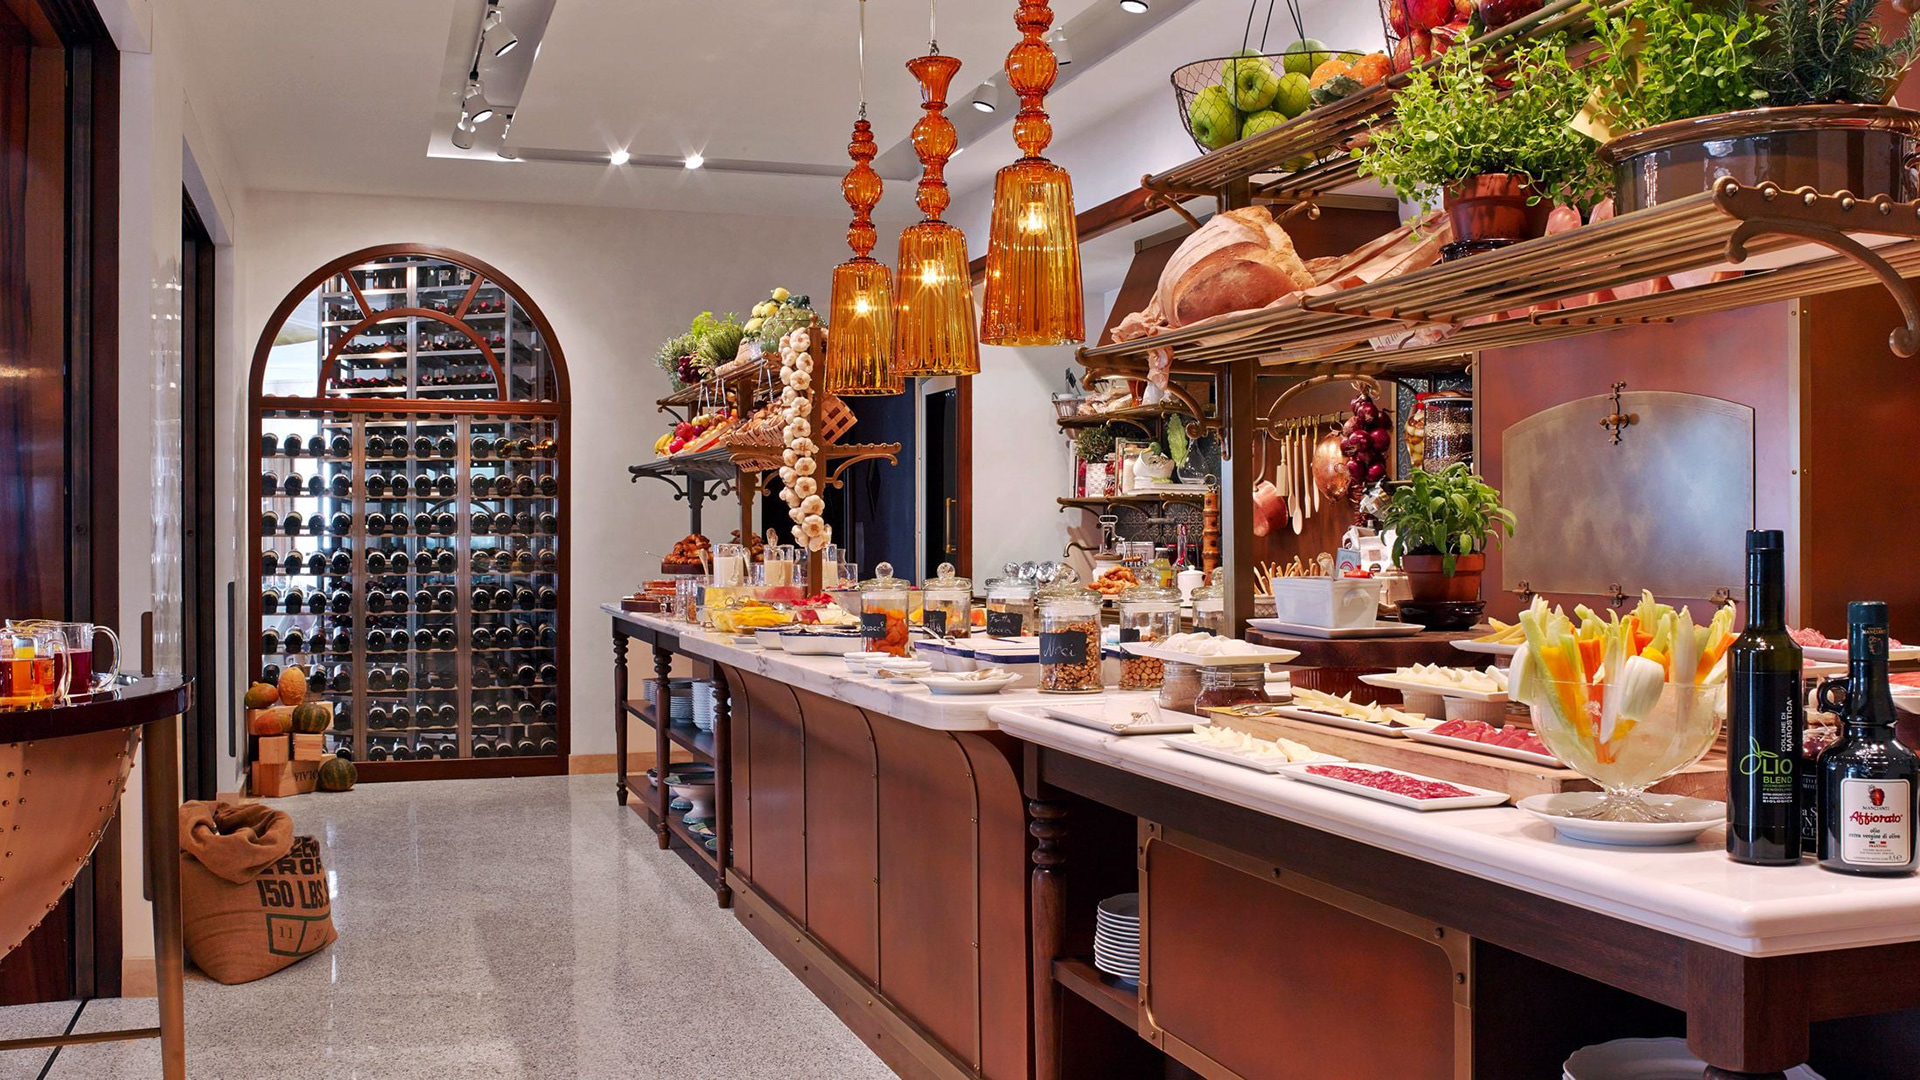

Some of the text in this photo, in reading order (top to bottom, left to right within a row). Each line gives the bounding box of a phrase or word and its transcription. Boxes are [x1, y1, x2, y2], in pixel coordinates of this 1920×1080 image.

[1763, 776, 1793, 784] BLEND
[1850, 811, 1903, 825] Affiorato
[256, 880, 294, 908] 150
[279, 926, 293, 939] 11
